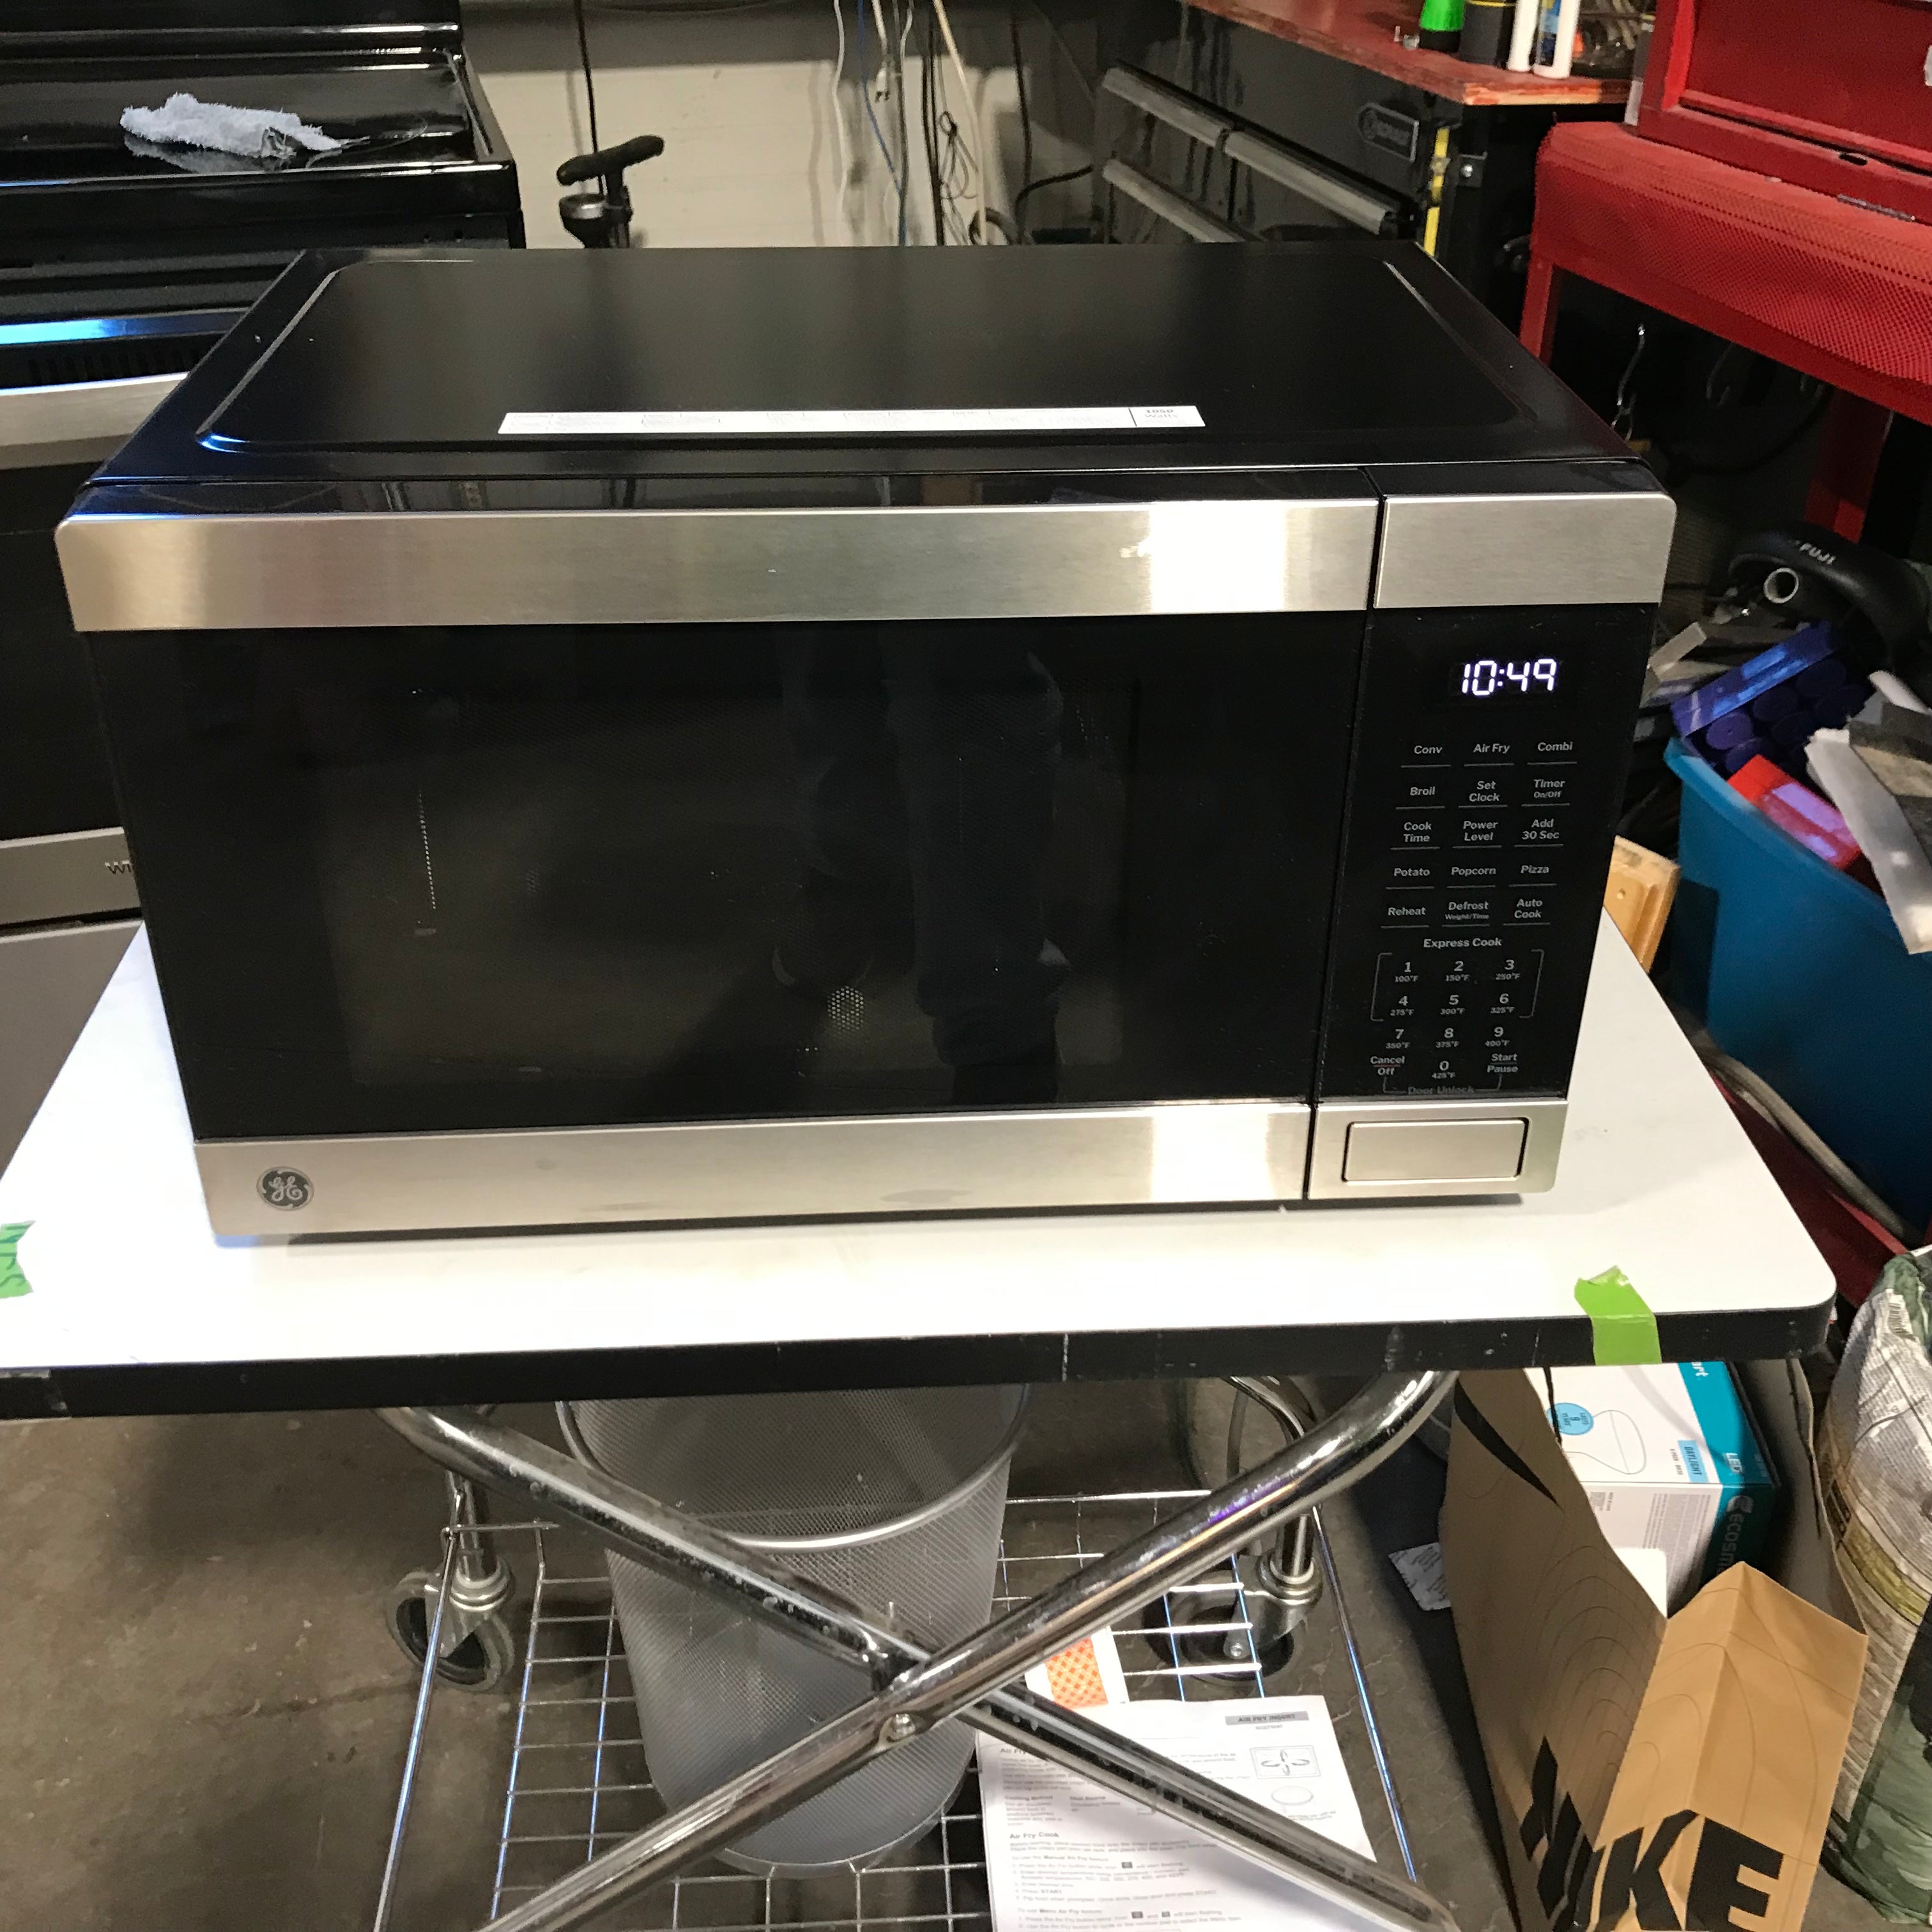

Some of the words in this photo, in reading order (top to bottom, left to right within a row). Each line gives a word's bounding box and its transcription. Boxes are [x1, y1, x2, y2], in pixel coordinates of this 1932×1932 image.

[1461, 658, 1558, 697] 10:49
[1414, 745, 1443, 755] Conv
[1473, 744, 1491, 753] Air
[1492, 743, 1510, 754] Fry
[1537, 741, 1573, 751] Combi
[1476, 781, 1496, 790] Set
[1533, 779, 1566, 788] Timer
[1409, 786, 1436, 796] Broil
[1533, 790, 1561, 799] On/Off
[1469, 792, 1499, 802] Clock
[1404, 821, 1432, 831] Cook
[1462, 820, 1498, 830] Power
[1531, 818, 1554, 828] Add
[1403, 833, 1430, 843] Time
[1464, 832, 1494, 841] Level
[1521, 831, 1537, 840] 30
[1539, 830, 1560, 839] Sec
[1393, 868, 1430, 877] Potato
[1451, 866, 1496, 877] Popcorn
[1521, 864, 1549, 873] Pizza
[1448, 901, 1489, 910] Defrost
[1516, 898, 1543, 907] Auto
[1388, 907, 1427, 916] Reheat
[1514, 909, 1542, 919] Cook
[1423, 939, 1470, 949] Express
[1472, 937, 1502, 947] Cook
[1404, 962, 1411, 972] 1
[1453, 960, 1464, 972] 2
[1504, 959, 1515, 970] 3
[1398, 995, 1409, 1006] 4
[1448, 994, 1459, 1006] 5
[1499, 993, 1509, 1004] 6
[1395, 1029, 1404, 1039] 7
[1444, 1027, 1454, 1039] 8
[1494, 1026, 1504, 1038] 9
[1370, 1055, 1406, 1064] Cancel
[1491, 1053, 1517, 1061] Start
[1377, 1067, 1395, 1075] Off
[1439, 1061, 1449, 1071] 0
[1683, 1446, 1703, 1476] DAYLIGHT
[1725, 1452, 1744, 1473] LED
[1717, 1513, 1745, 1573] ecosm
